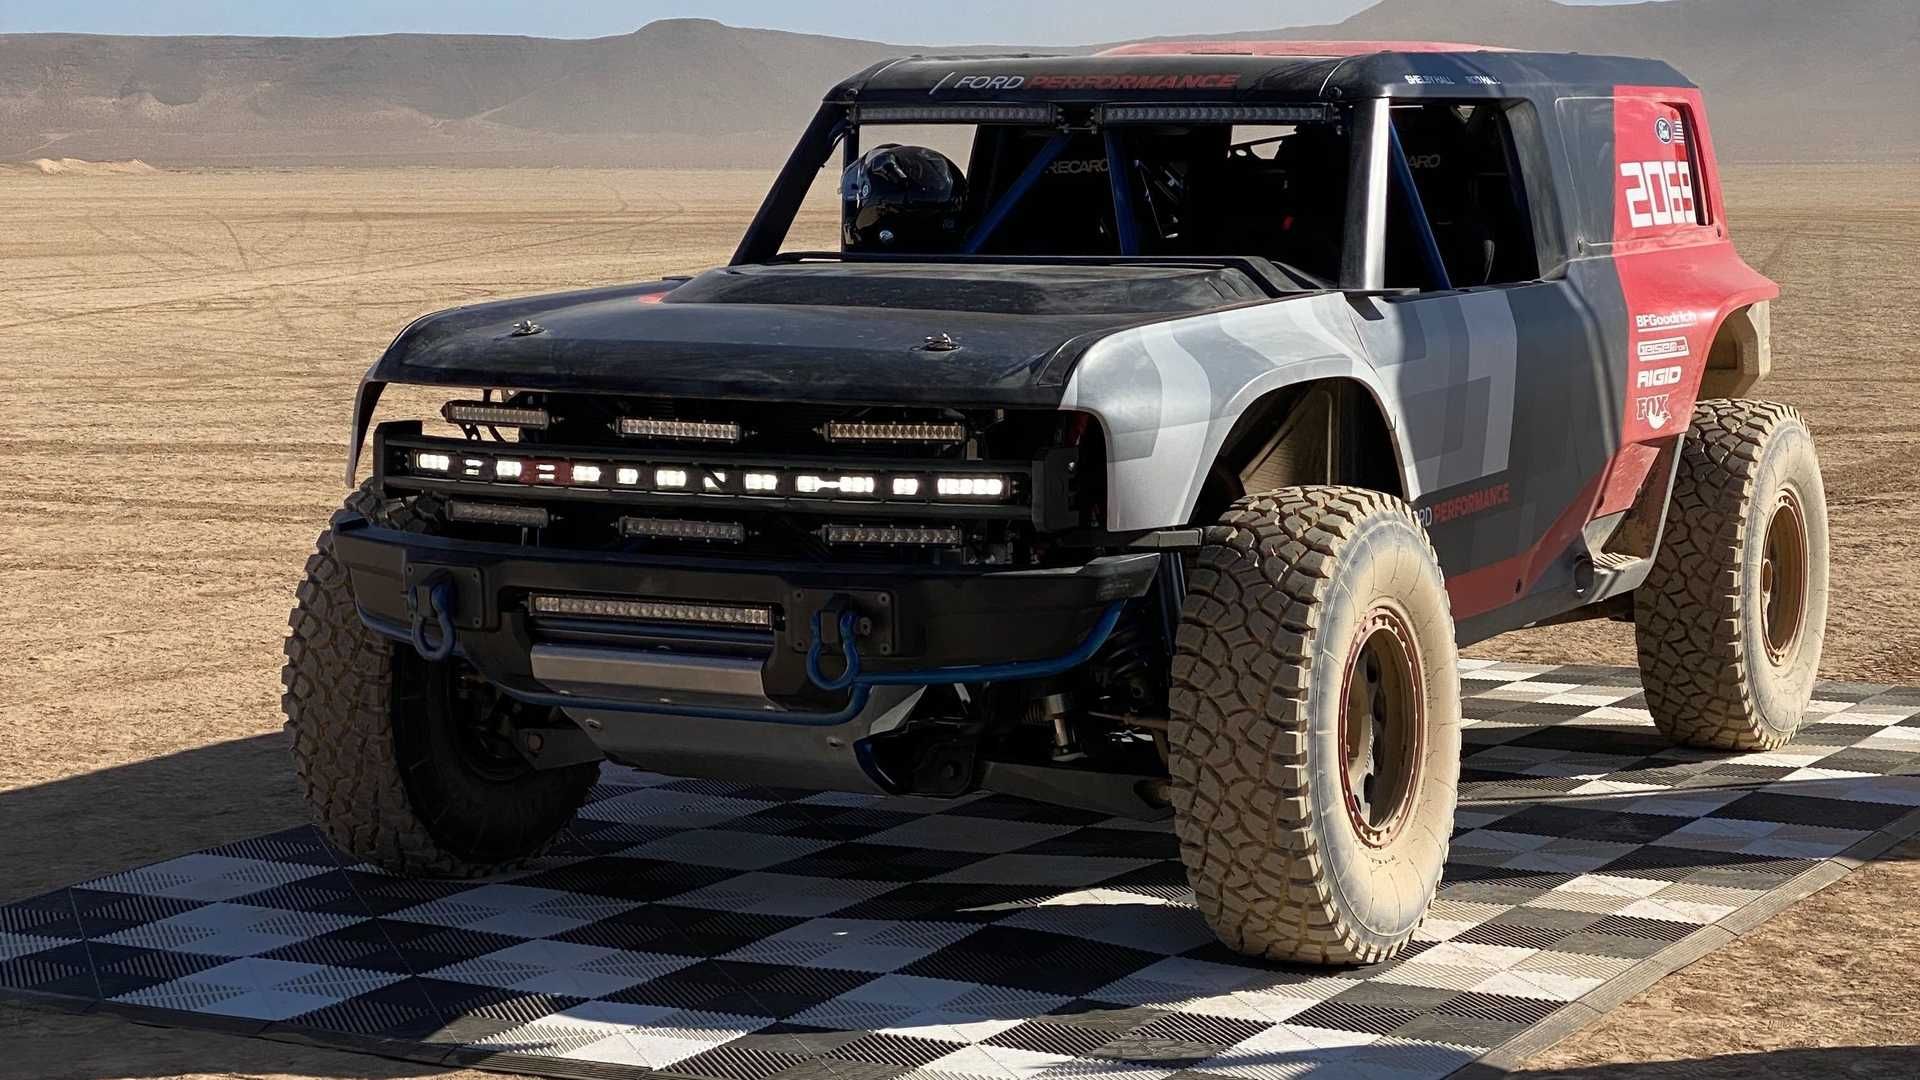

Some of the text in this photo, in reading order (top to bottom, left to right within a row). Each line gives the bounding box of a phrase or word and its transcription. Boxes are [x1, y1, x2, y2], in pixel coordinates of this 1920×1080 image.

[954, 74, 1242, 90] FORD PERFORMANCE
[1407, 154, 1441, 169] ARO
[1636, 311, 1695, 327] BFGoodrich
[1637, 366, 1682, 389] RIGID
[1637, 395, 1671, 420] FOX
[1413, 483, 1511, 528] RD PERFORMANCE
